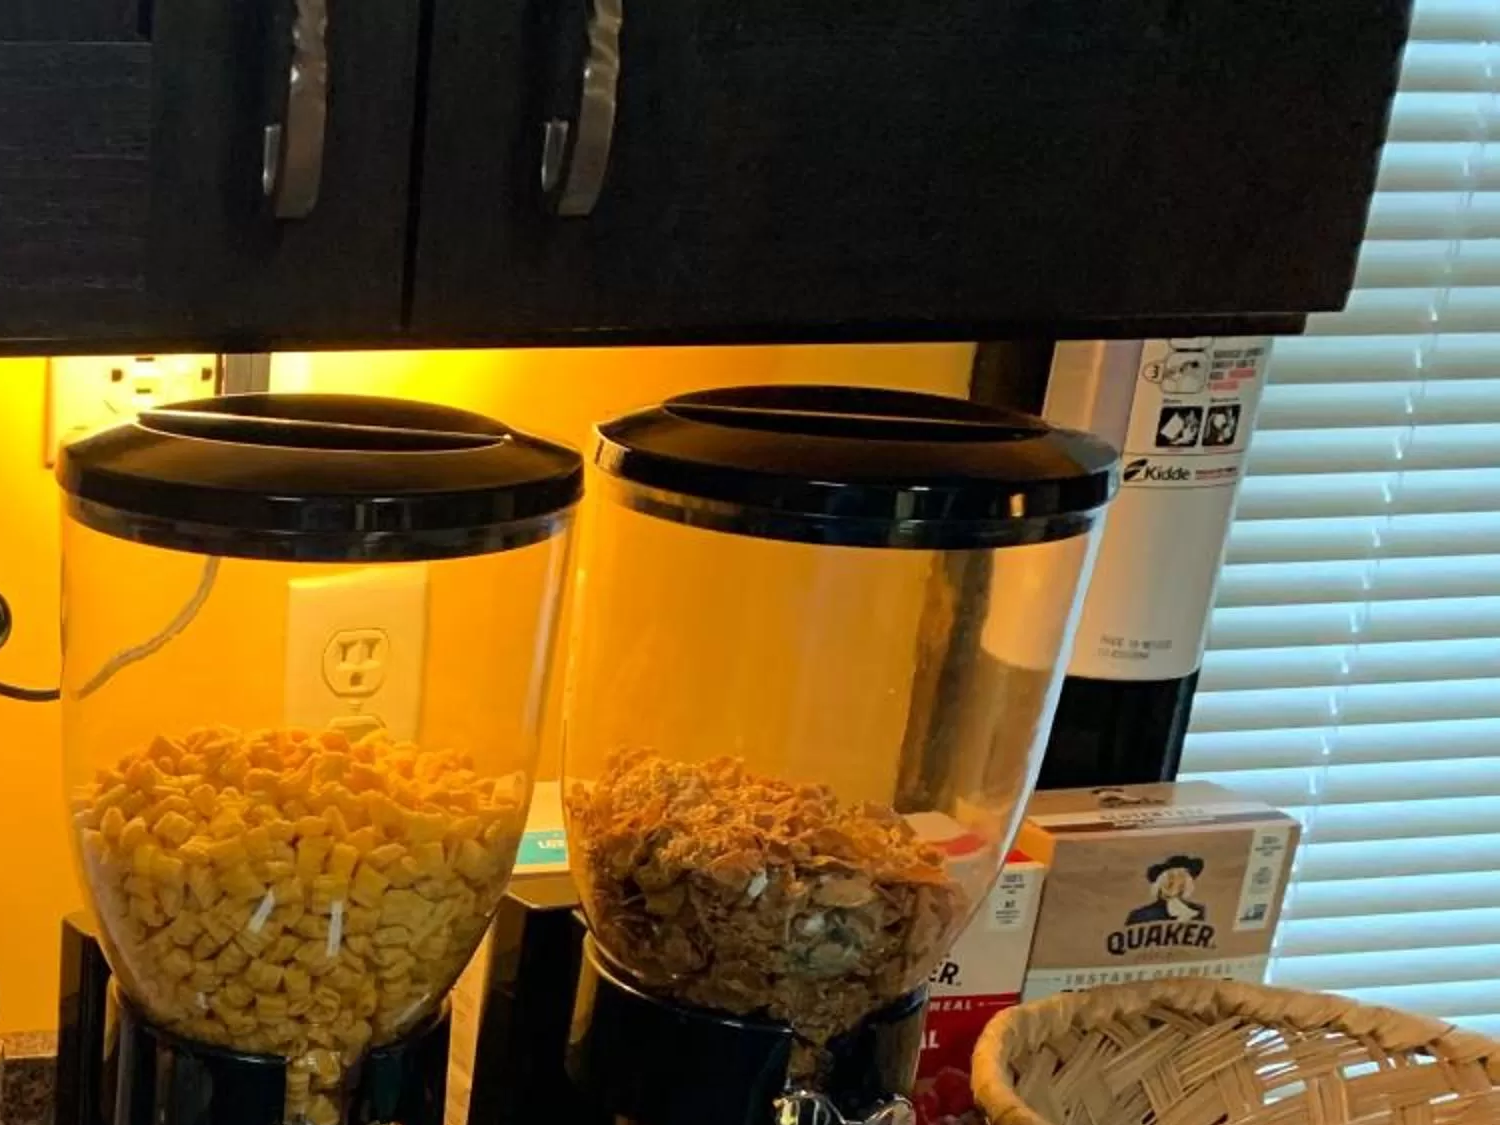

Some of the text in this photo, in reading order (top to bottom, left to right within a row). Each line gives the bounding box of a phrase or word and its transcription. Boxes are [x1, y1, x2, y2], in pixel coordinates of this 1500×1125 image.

[1144, 466, 1191, 481] Kidde
[1107, 924, 1215, 955] QUAKER
[928, 1000, 972, 1012] MEAL
